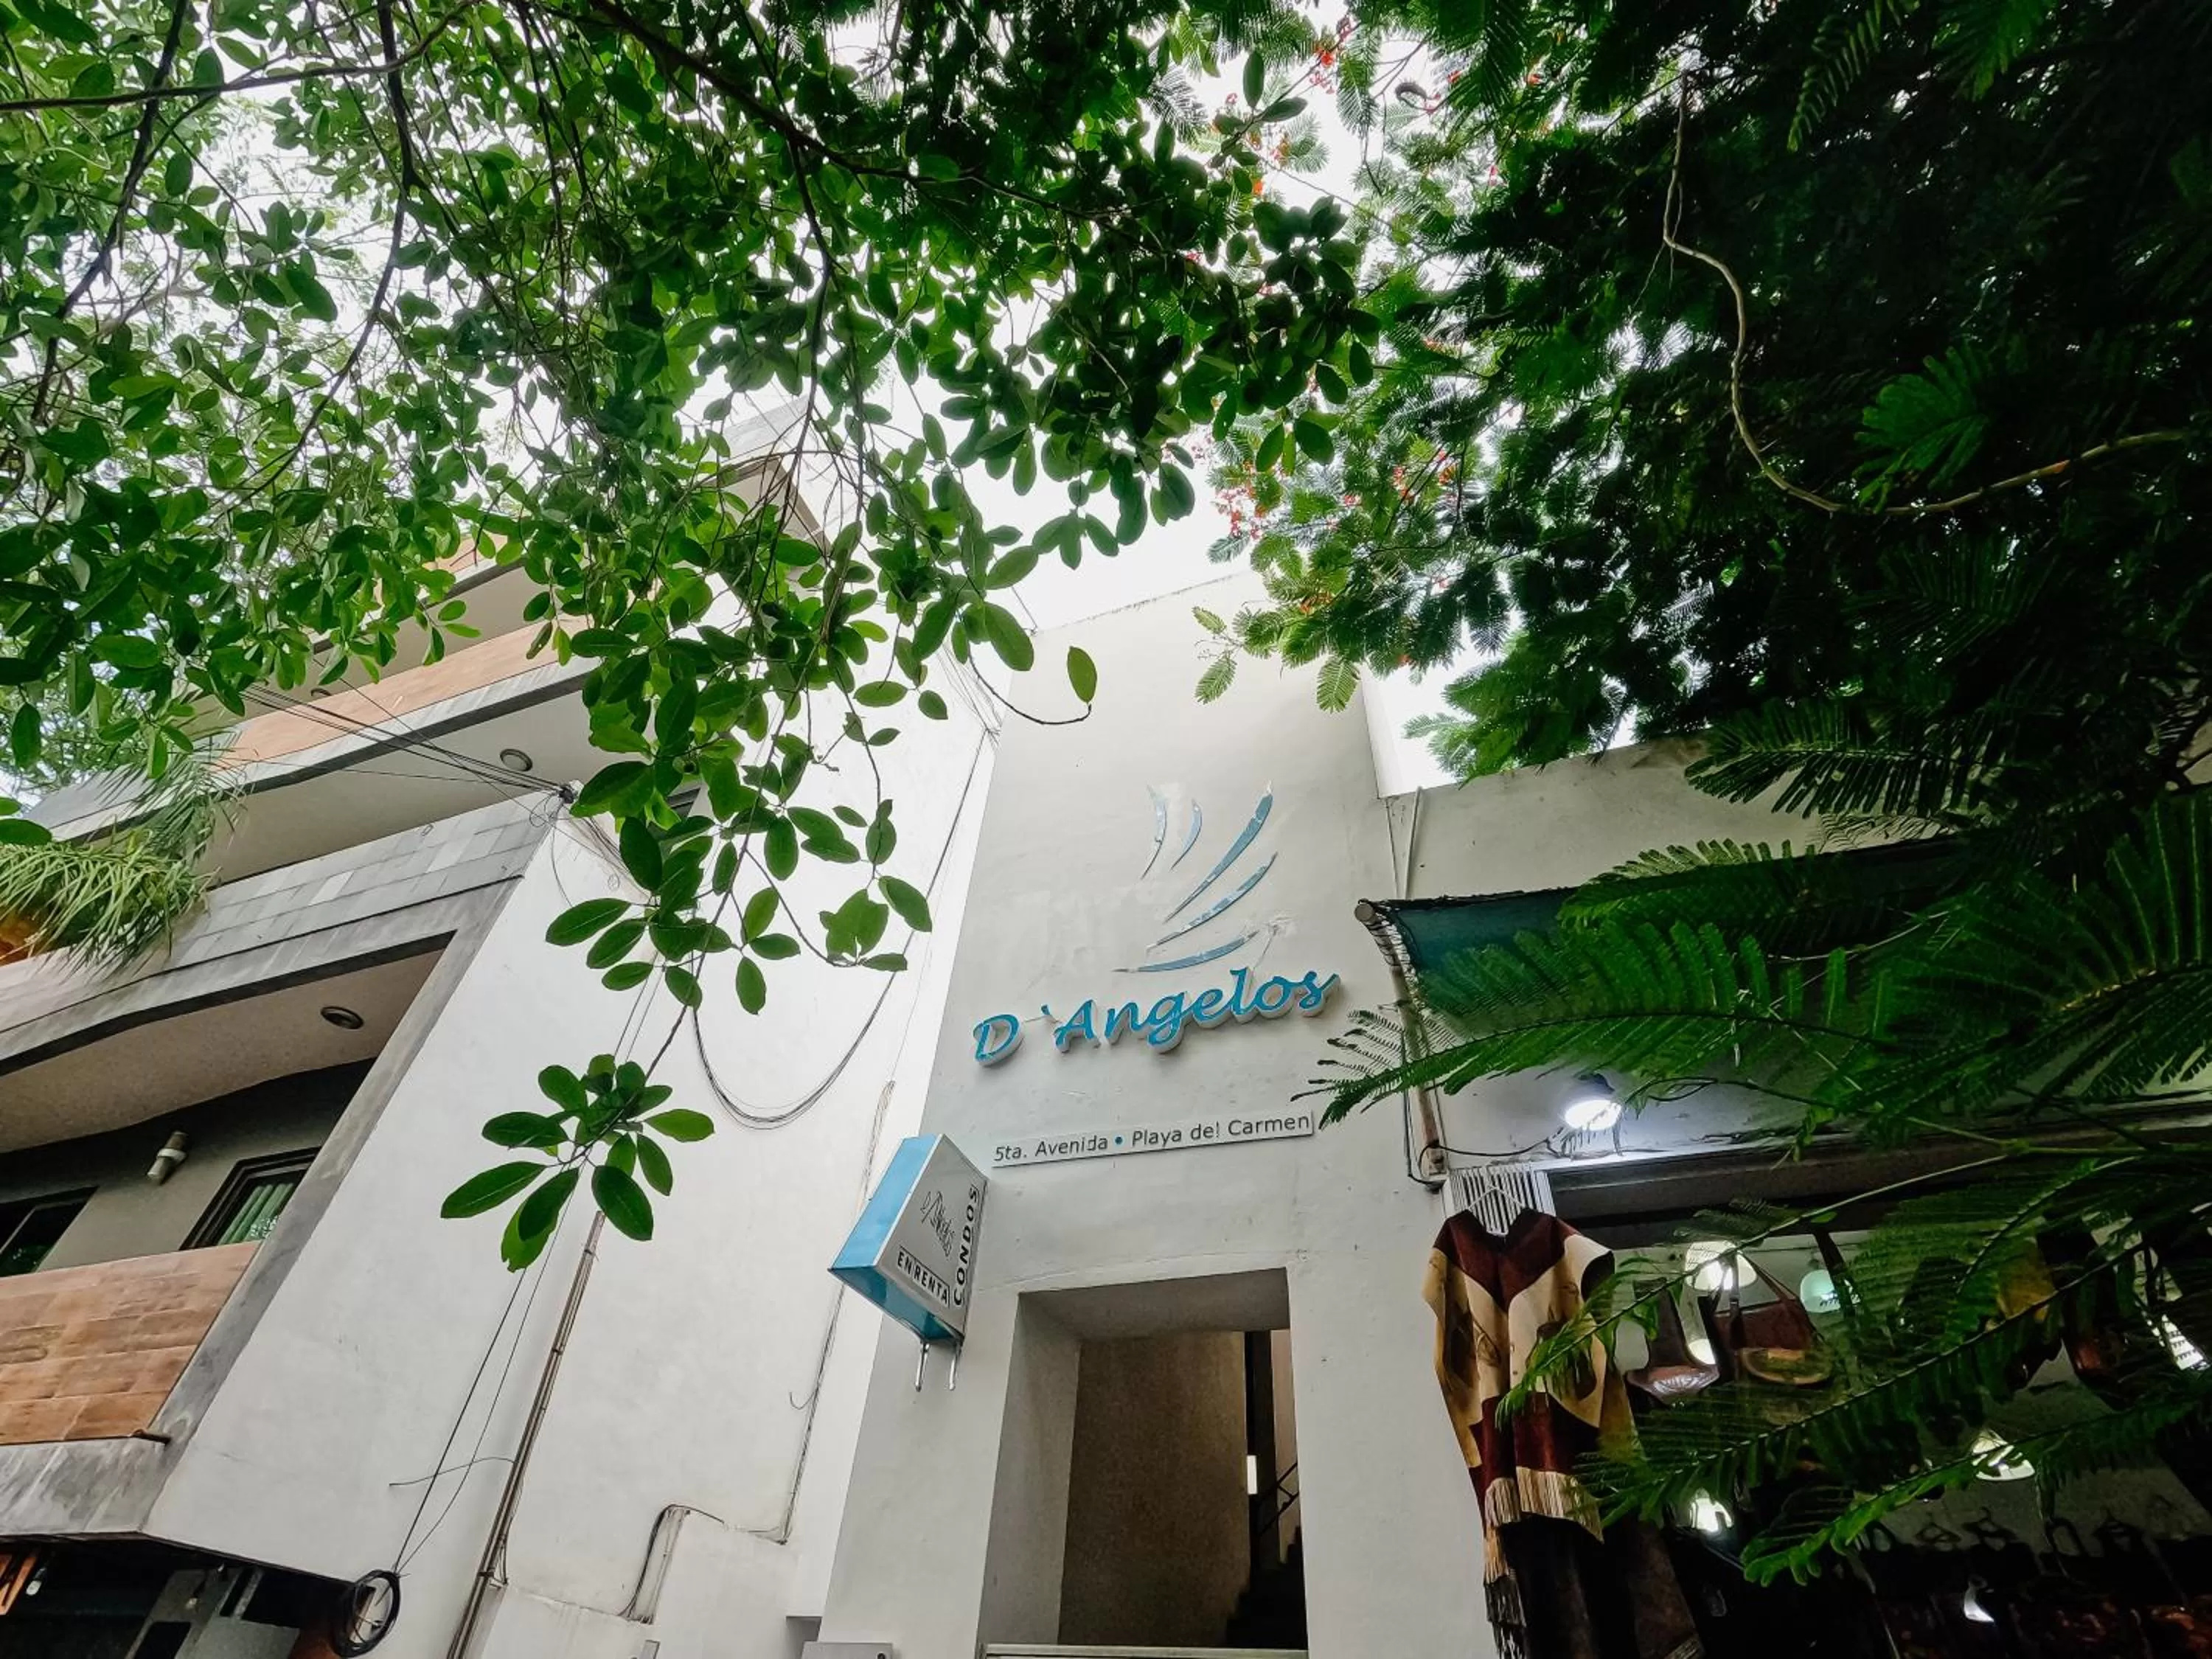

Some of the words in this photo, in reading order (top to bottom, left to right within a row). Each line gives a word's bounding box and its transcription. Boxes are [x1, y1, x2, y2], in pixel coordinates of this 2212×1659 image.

[993, 1146, 1027, 1161] 5ta.
[1034, 1135, 1108, 1157] Avenida
[1132, 1129, 1182, 1148] Playa
[1190, 1121, 1220, 1141] del
[1228, 1115, 1310, 1136] Carmen
[954, 1187, 978, 1306] CONDOS
